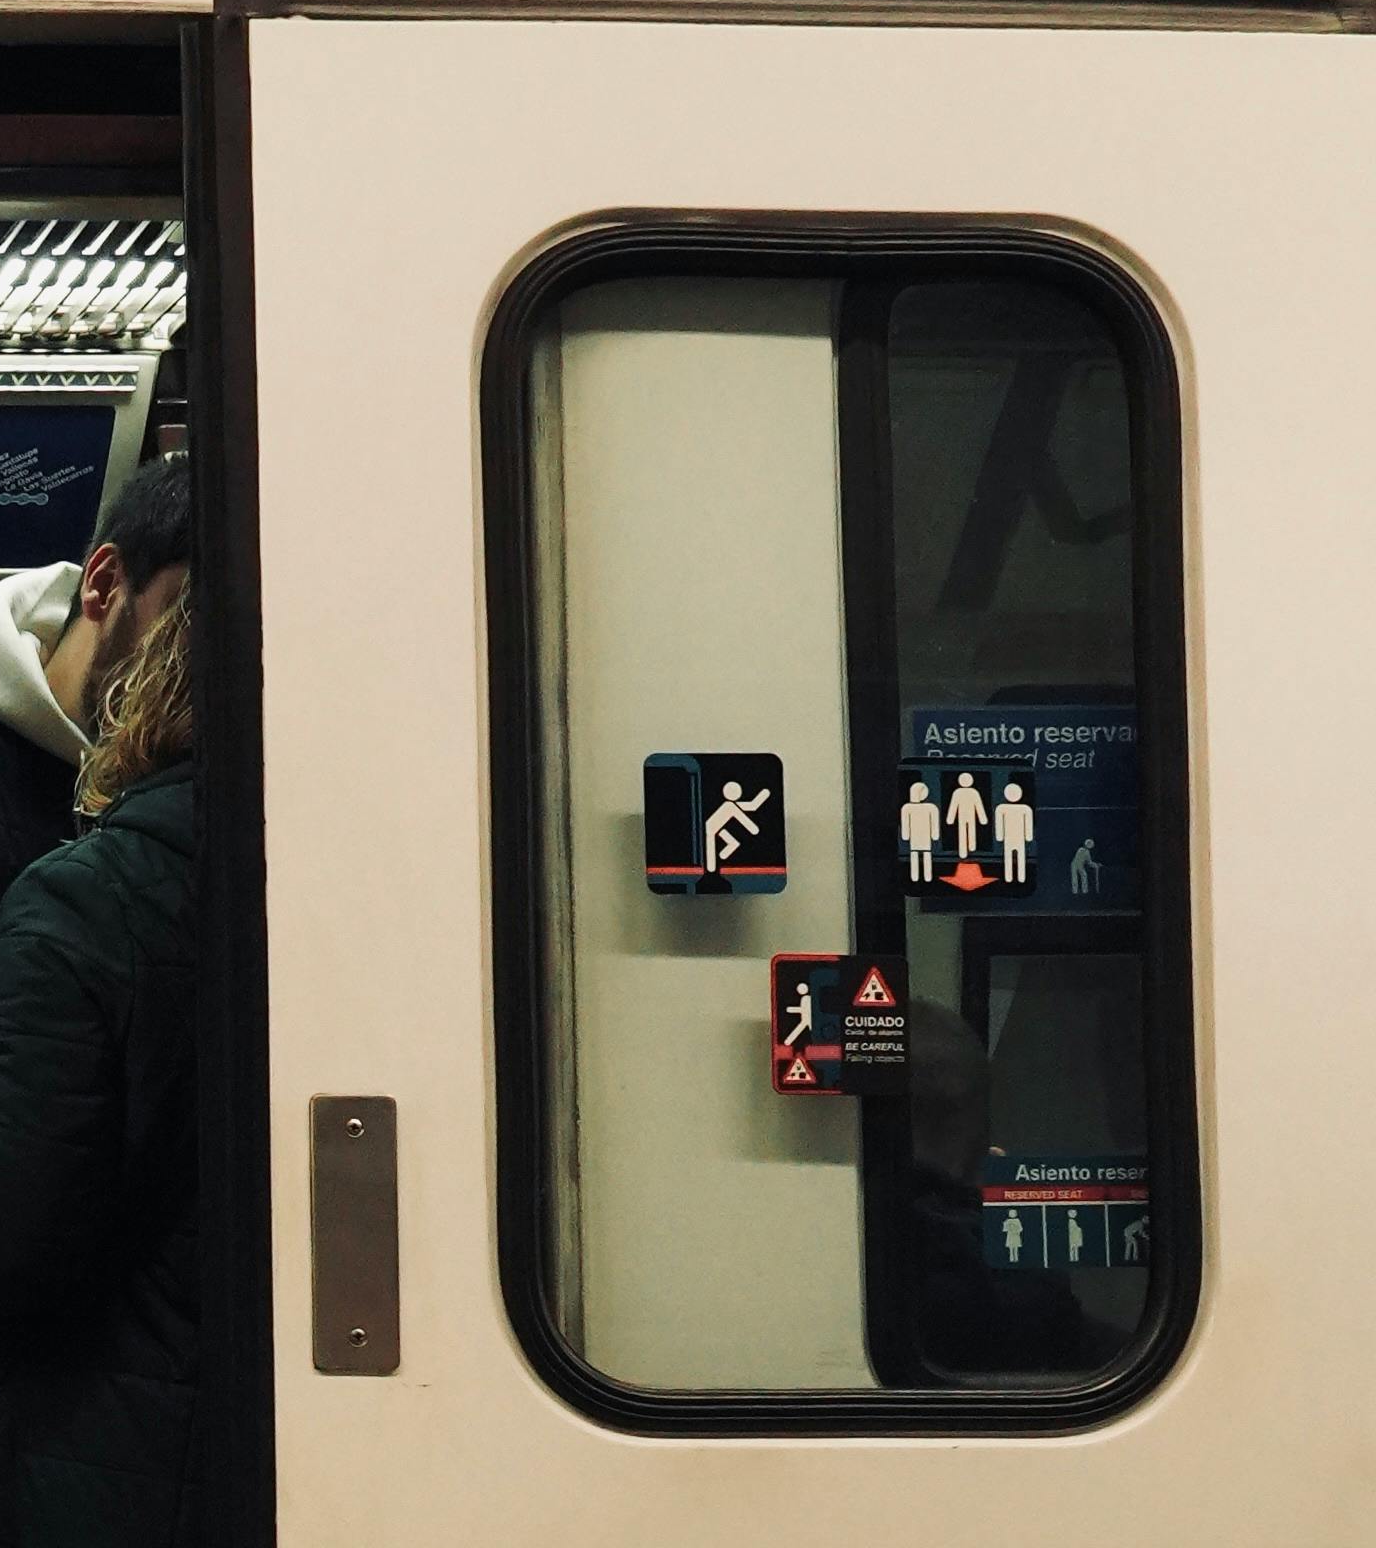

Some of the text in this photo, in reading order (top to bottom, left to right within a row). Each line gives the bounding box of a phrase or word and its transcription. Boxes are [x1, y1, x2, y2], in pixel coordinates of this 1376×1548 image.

[924, 723, 1136, 744] Asiento reserva
[1045, 749, 1096, 769] seat
[845, 1016, 905, 1028] CUIDADO
[845, 1042, 905, 1051] BE CAREFUL
[1015, 1163, 1091, 1181] Asiento
[1004, 1189, 1084, 1200] RESERVED SEAT
